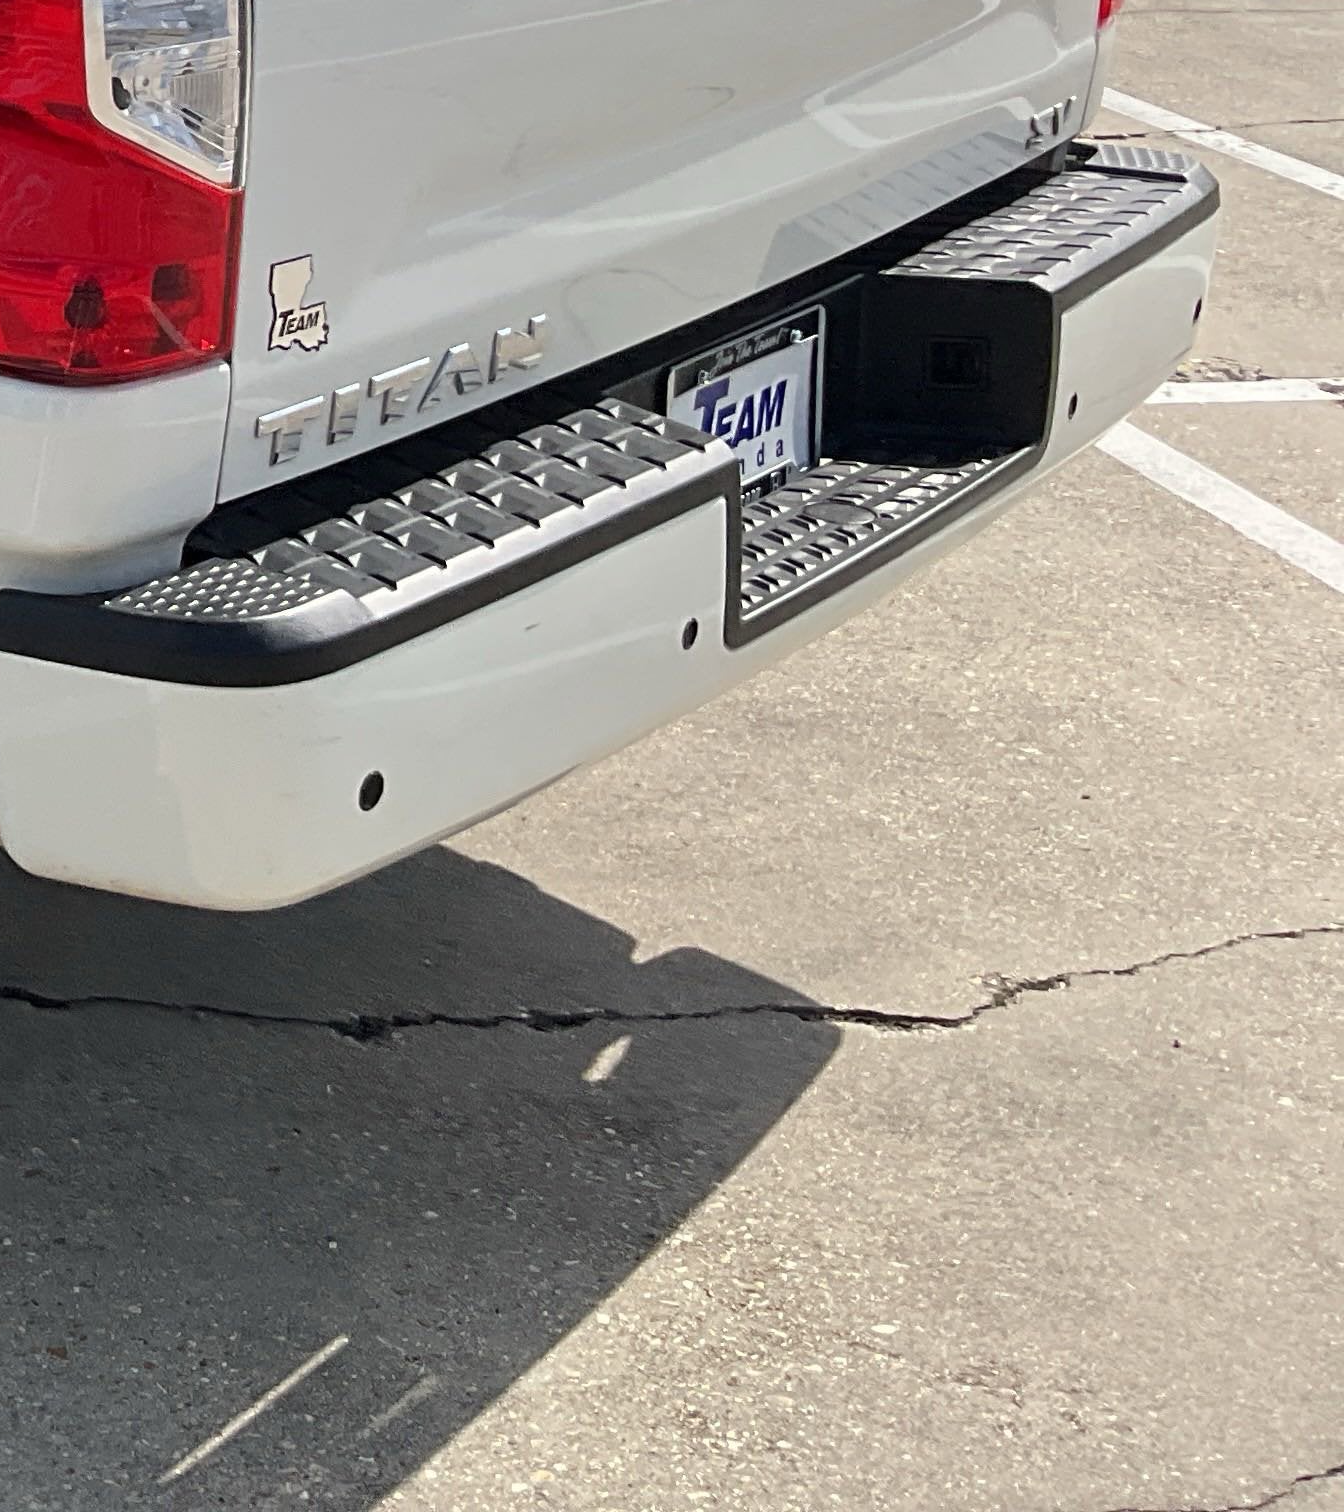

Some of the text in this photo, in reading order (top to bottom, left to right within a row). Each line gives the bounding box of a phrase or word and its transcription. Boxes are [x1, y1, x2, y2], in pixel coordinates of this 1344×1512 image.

[278, 308, 320, 338] TEAM
[254, 313, 548, 467] TITAN
[693, 377, 788, 449] TEAM
